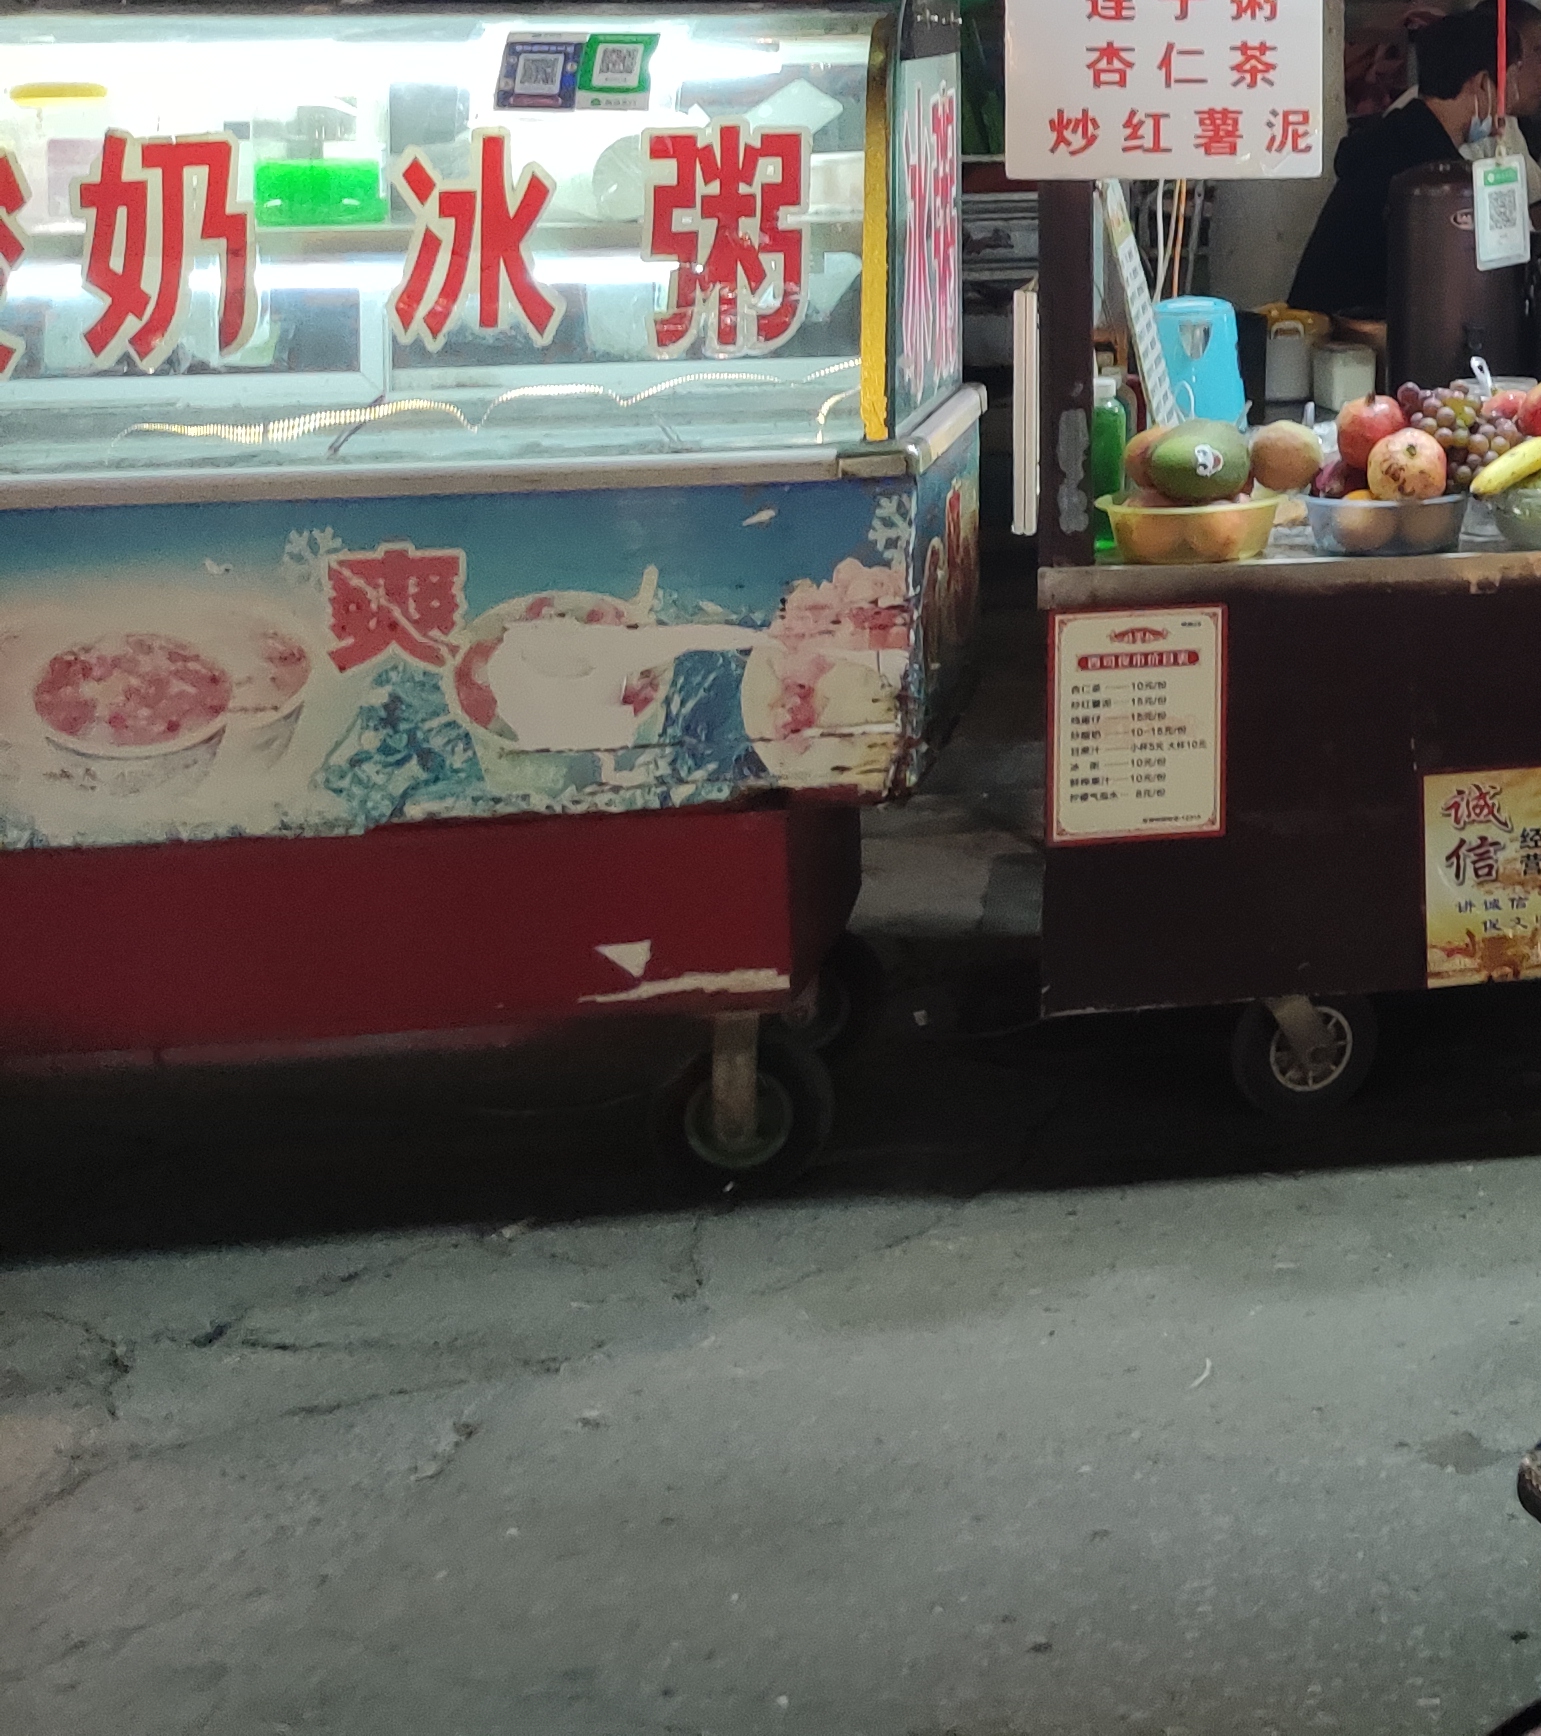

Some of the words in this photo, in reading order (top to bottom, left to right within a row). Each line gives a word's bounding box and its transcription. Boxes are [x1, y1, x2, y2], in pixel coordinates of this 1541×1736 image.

[1086, 41, 1278, 88] 杏仁茶
[1048, 107, 1312, 157] 炒红薯泥
[392, 122, 808, 356] 冰粥
[1442, 784, 1512, 885] 诚信
